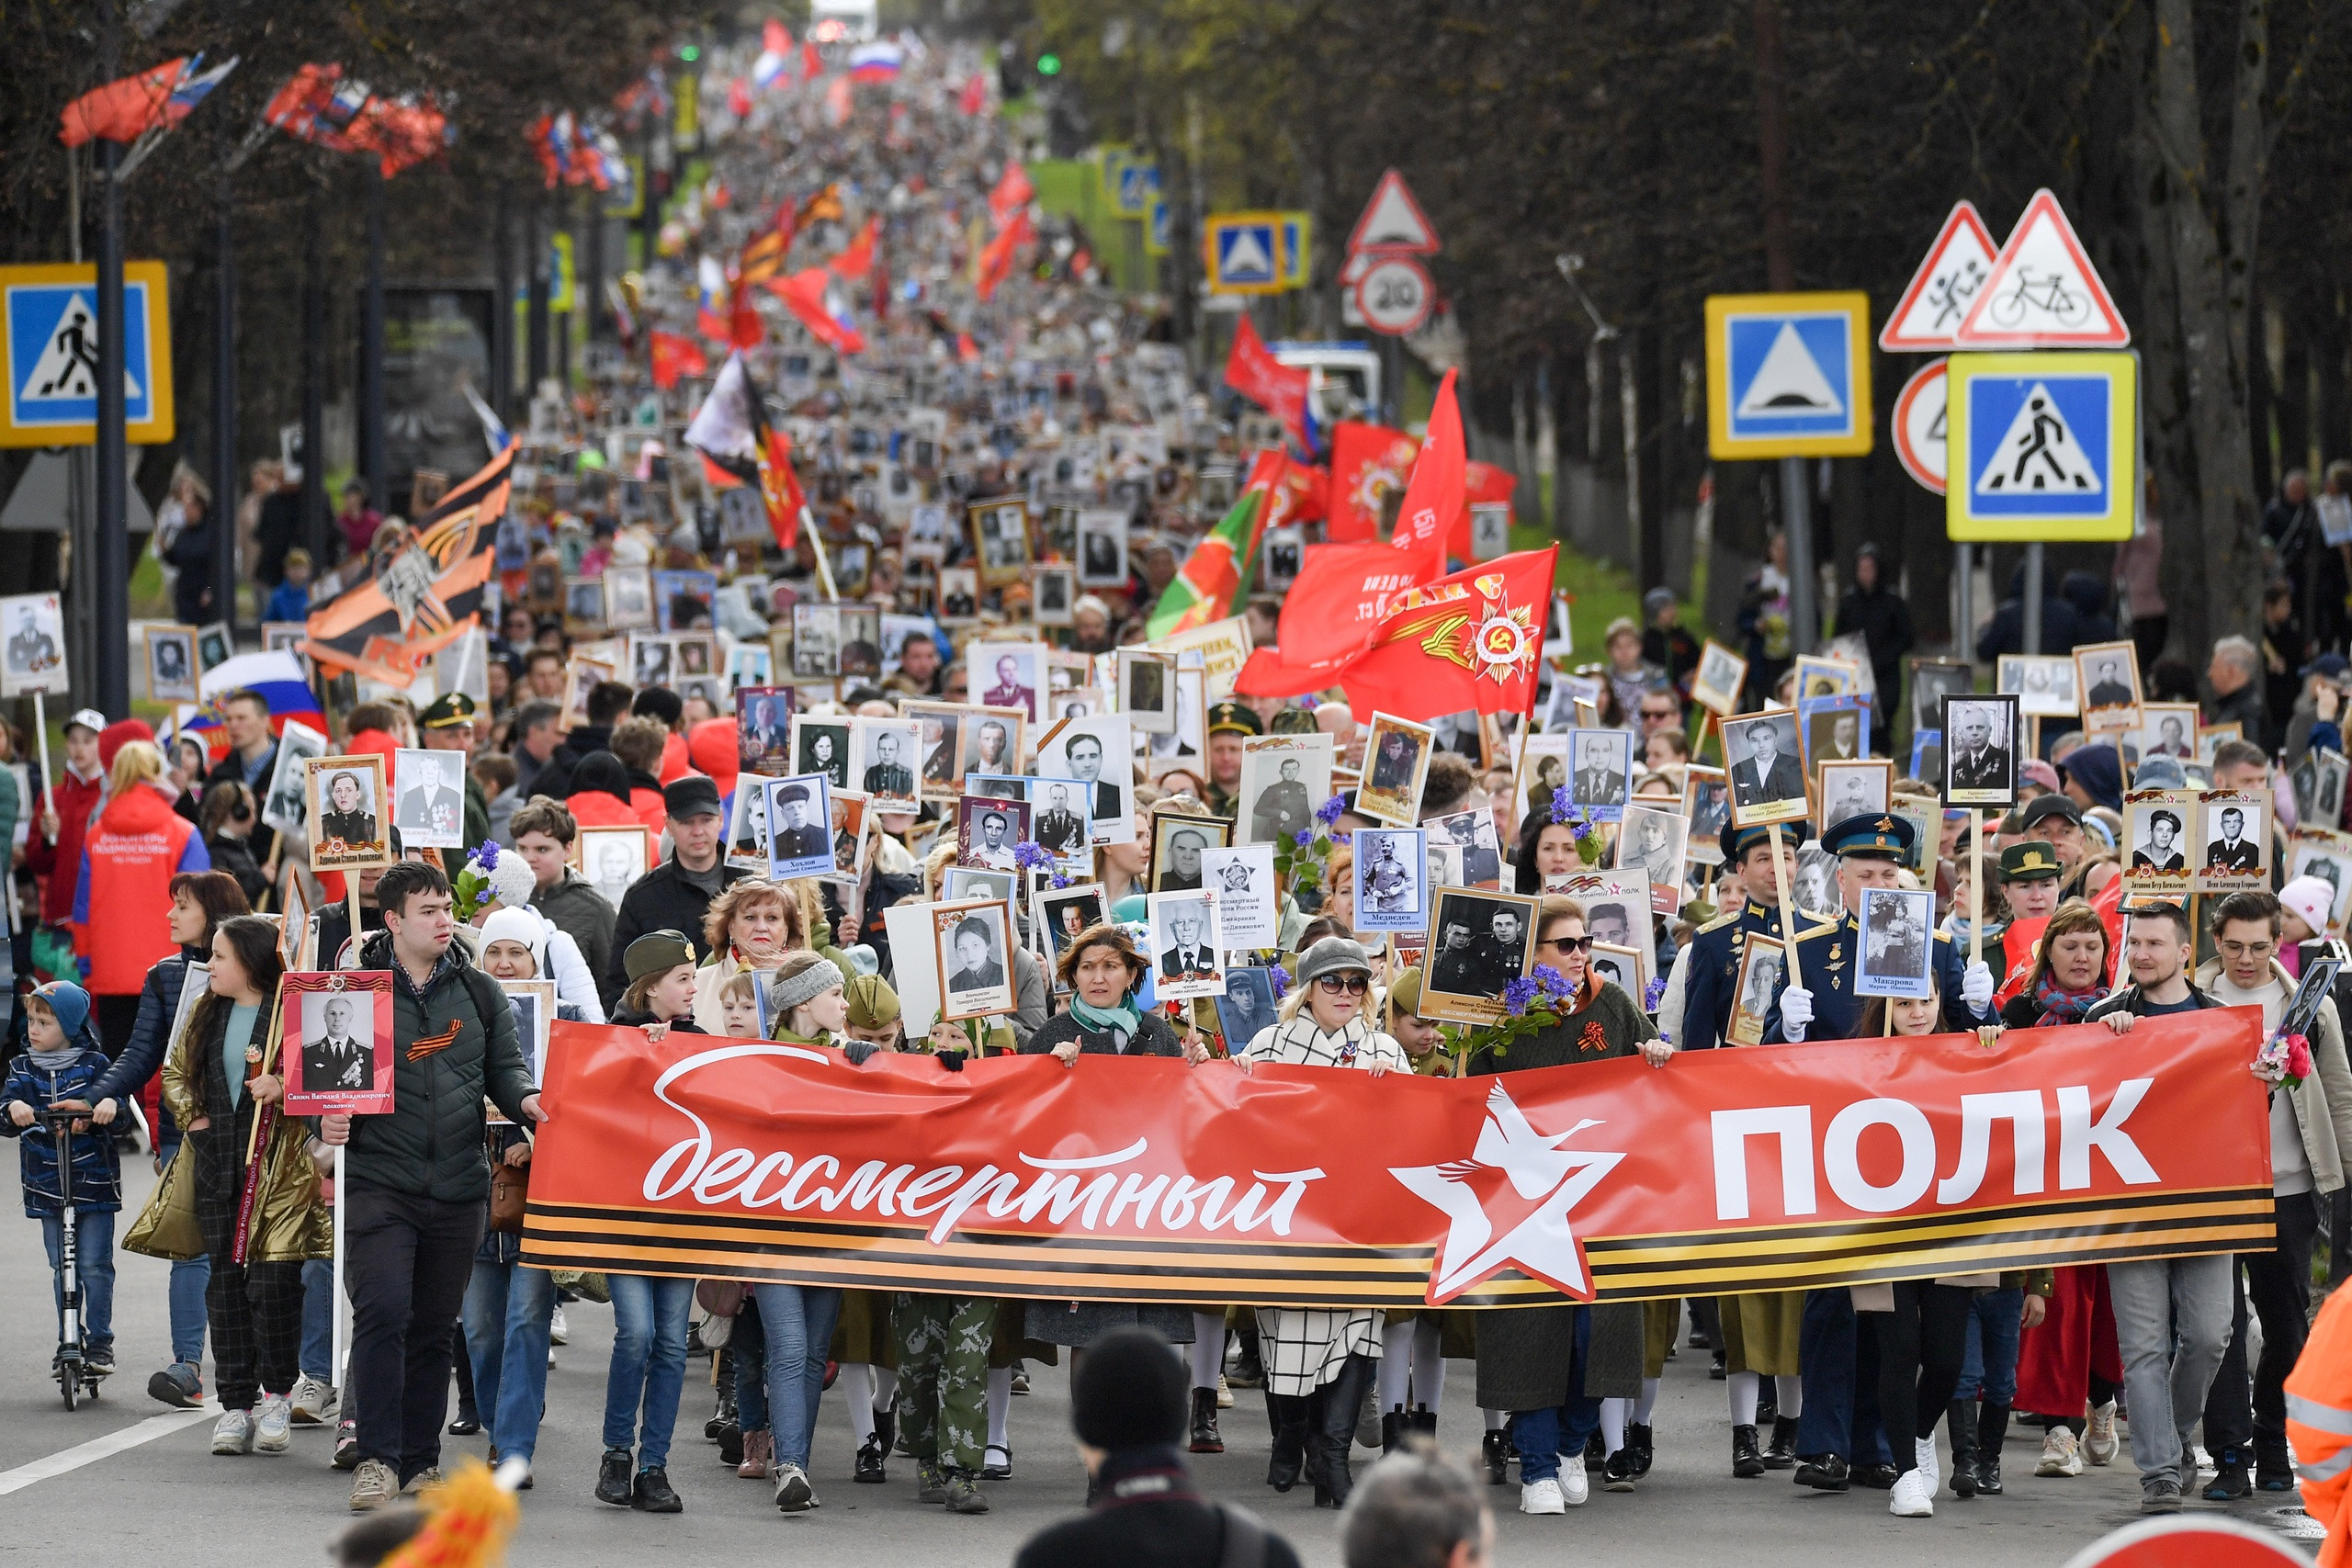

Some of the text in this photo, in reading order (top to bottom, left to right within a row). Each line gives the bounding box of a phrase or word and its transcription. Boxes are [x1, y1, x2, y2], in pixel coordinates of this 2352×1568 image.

[1376, 279, 1413, 309] 20
[790, 860, 816, 868] Хохлов
[1873, 976, 1913, 986] Макарова
[1440, 1009, 1486, 1020] БЕССМЕРТНЫЙ
[288, 1092, 391, 1101] Санин Василий Владимирович
[643, 1043, 1328, 1246] Бессмертный
[1711, 1077, 2162, 1221] ПОЛК
